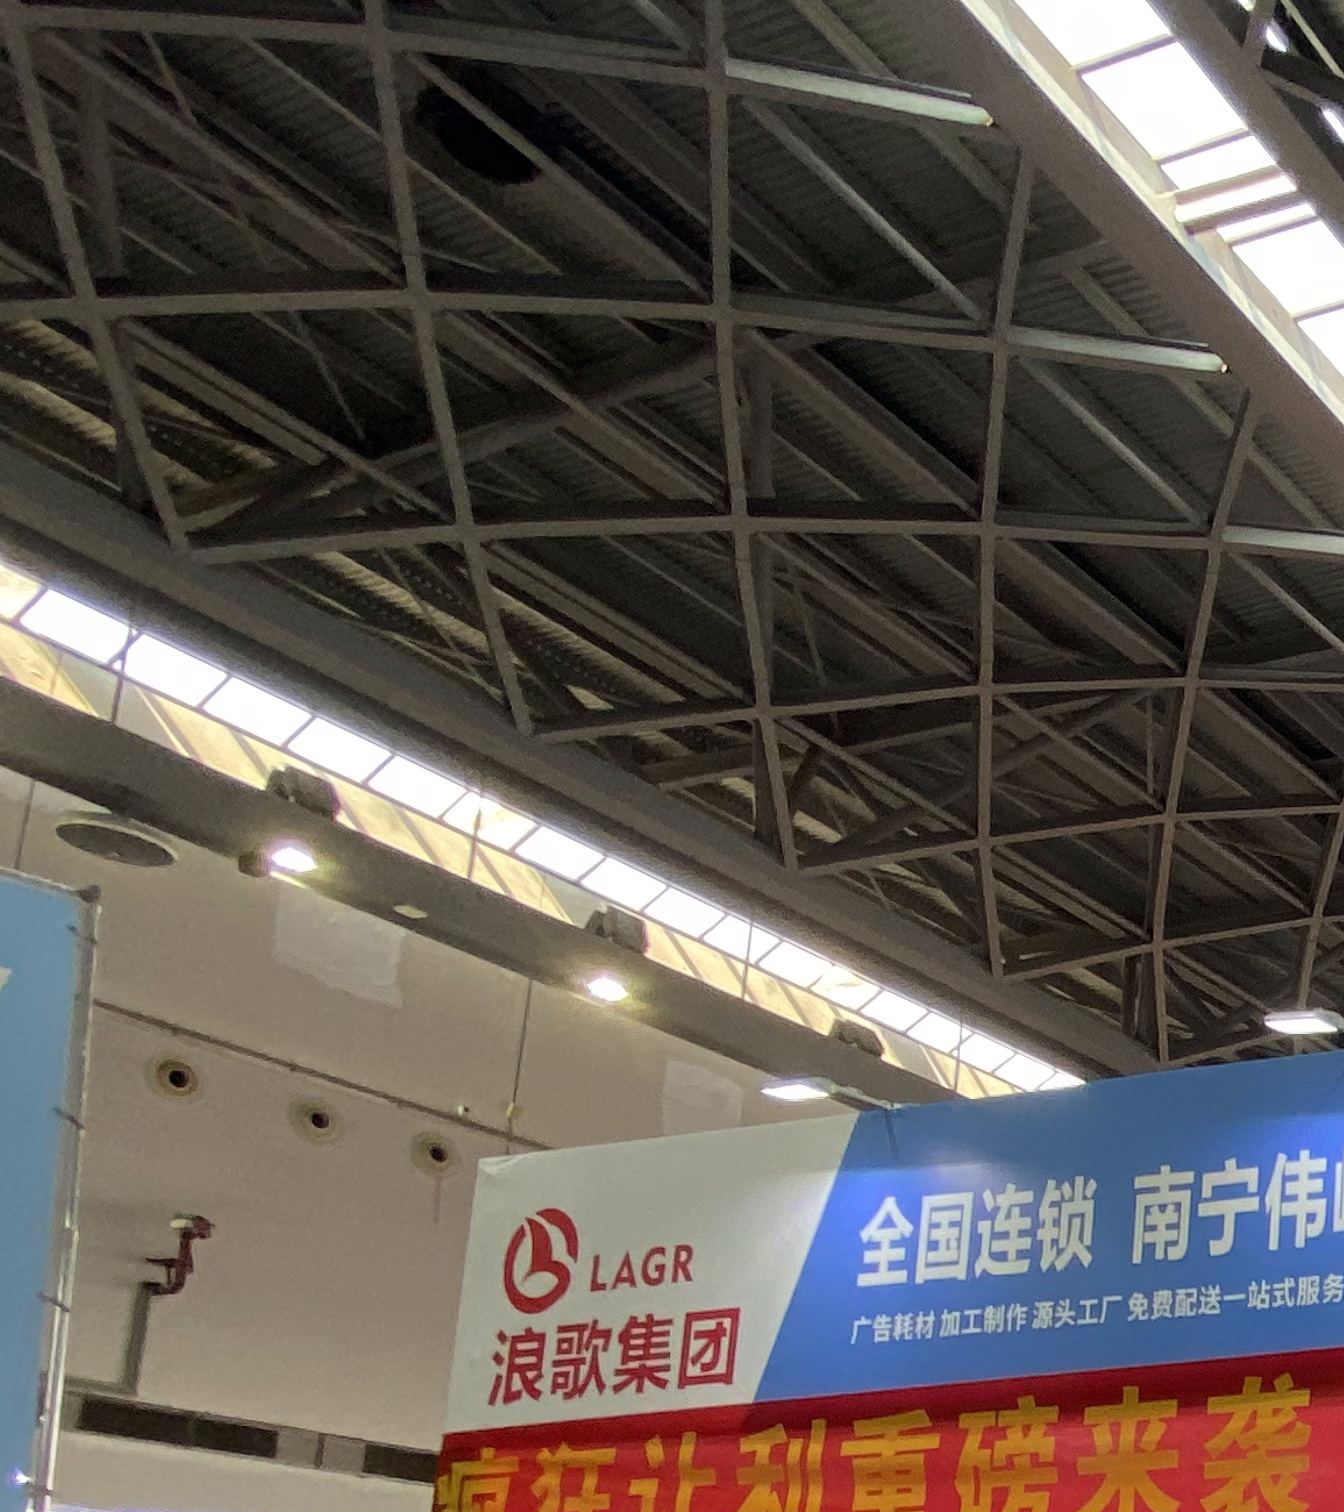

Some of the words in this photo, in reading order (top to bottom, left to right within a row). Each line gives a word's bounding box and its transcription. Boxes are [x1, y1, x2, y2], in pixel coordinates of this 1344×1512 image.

[591, 1245, 694, 1292] LAGR
[856, 1177, 1096, 1289] 全国连锁
[486, 1304, 739, 1406] 浪歌集团
[850, 1301, 935, 1345] 广告耗材
[939, 1296, 1028, 1338] 加工制作
[1031, 1291, 1122, 1333] 源头工厂
